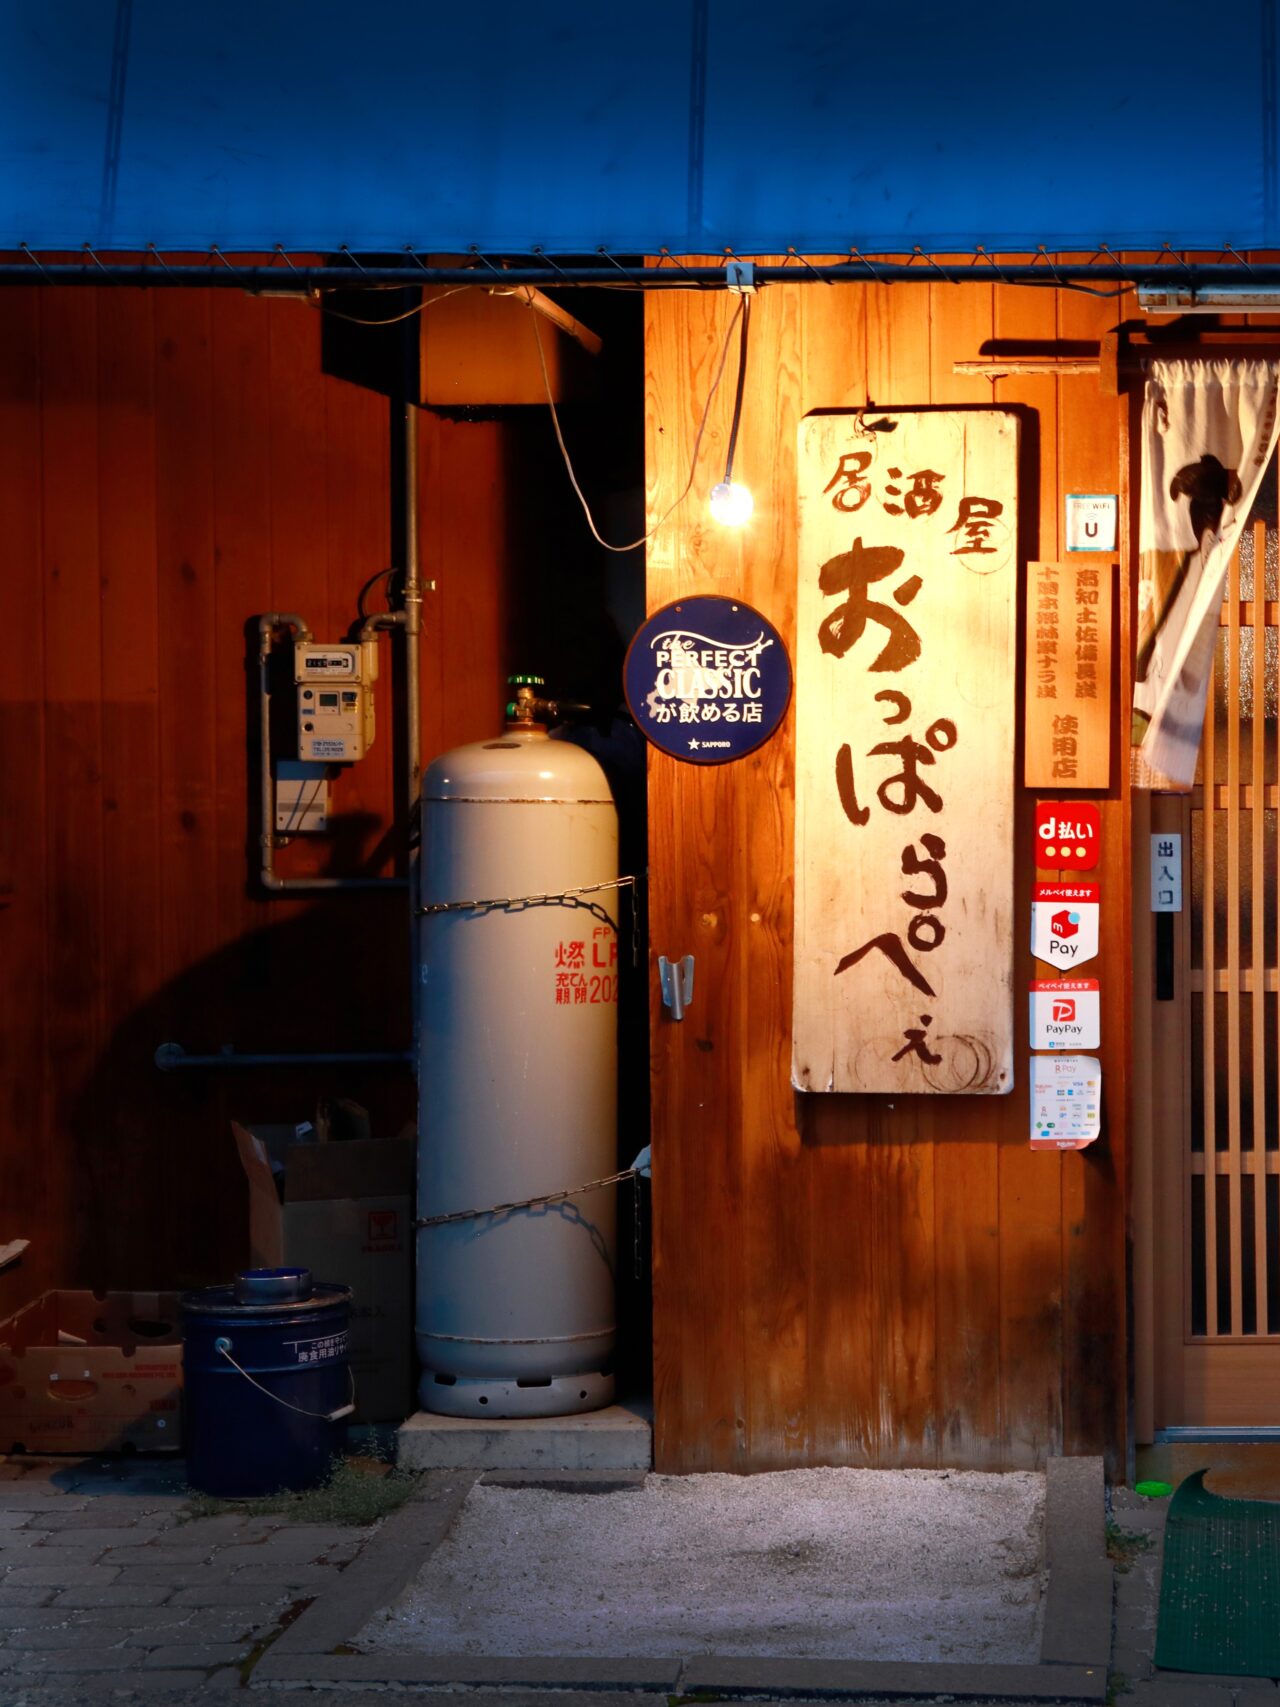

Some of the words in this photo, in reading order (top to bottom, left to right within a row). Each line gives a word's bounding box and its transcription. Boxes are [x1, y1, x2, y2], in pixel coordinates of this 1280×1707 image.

[822, 450, 1004, 556] 居酒屋
[1085, 522, 1098, 538] U
[662, 633, 695, 650] the
[656, 650, 758, 668] PERFECT
[656, 667, 762, 699] CLASSIC
[656, 701, 763, 723] が飲める店
[1052, 714, 1078, 779] 使用店
[1038, 817, 1093, 840] d払い
[1158, 841, 1174, 905] 出入口
[1039, 889, 1092, 897] メルペイ使えます
[555, 941, 585, 969] 燃
[1050, 941, 1079, 958] Pay
[556, 987, 587, 1005] 期限
[1046, 1024, 1083, 1035] PayPay
